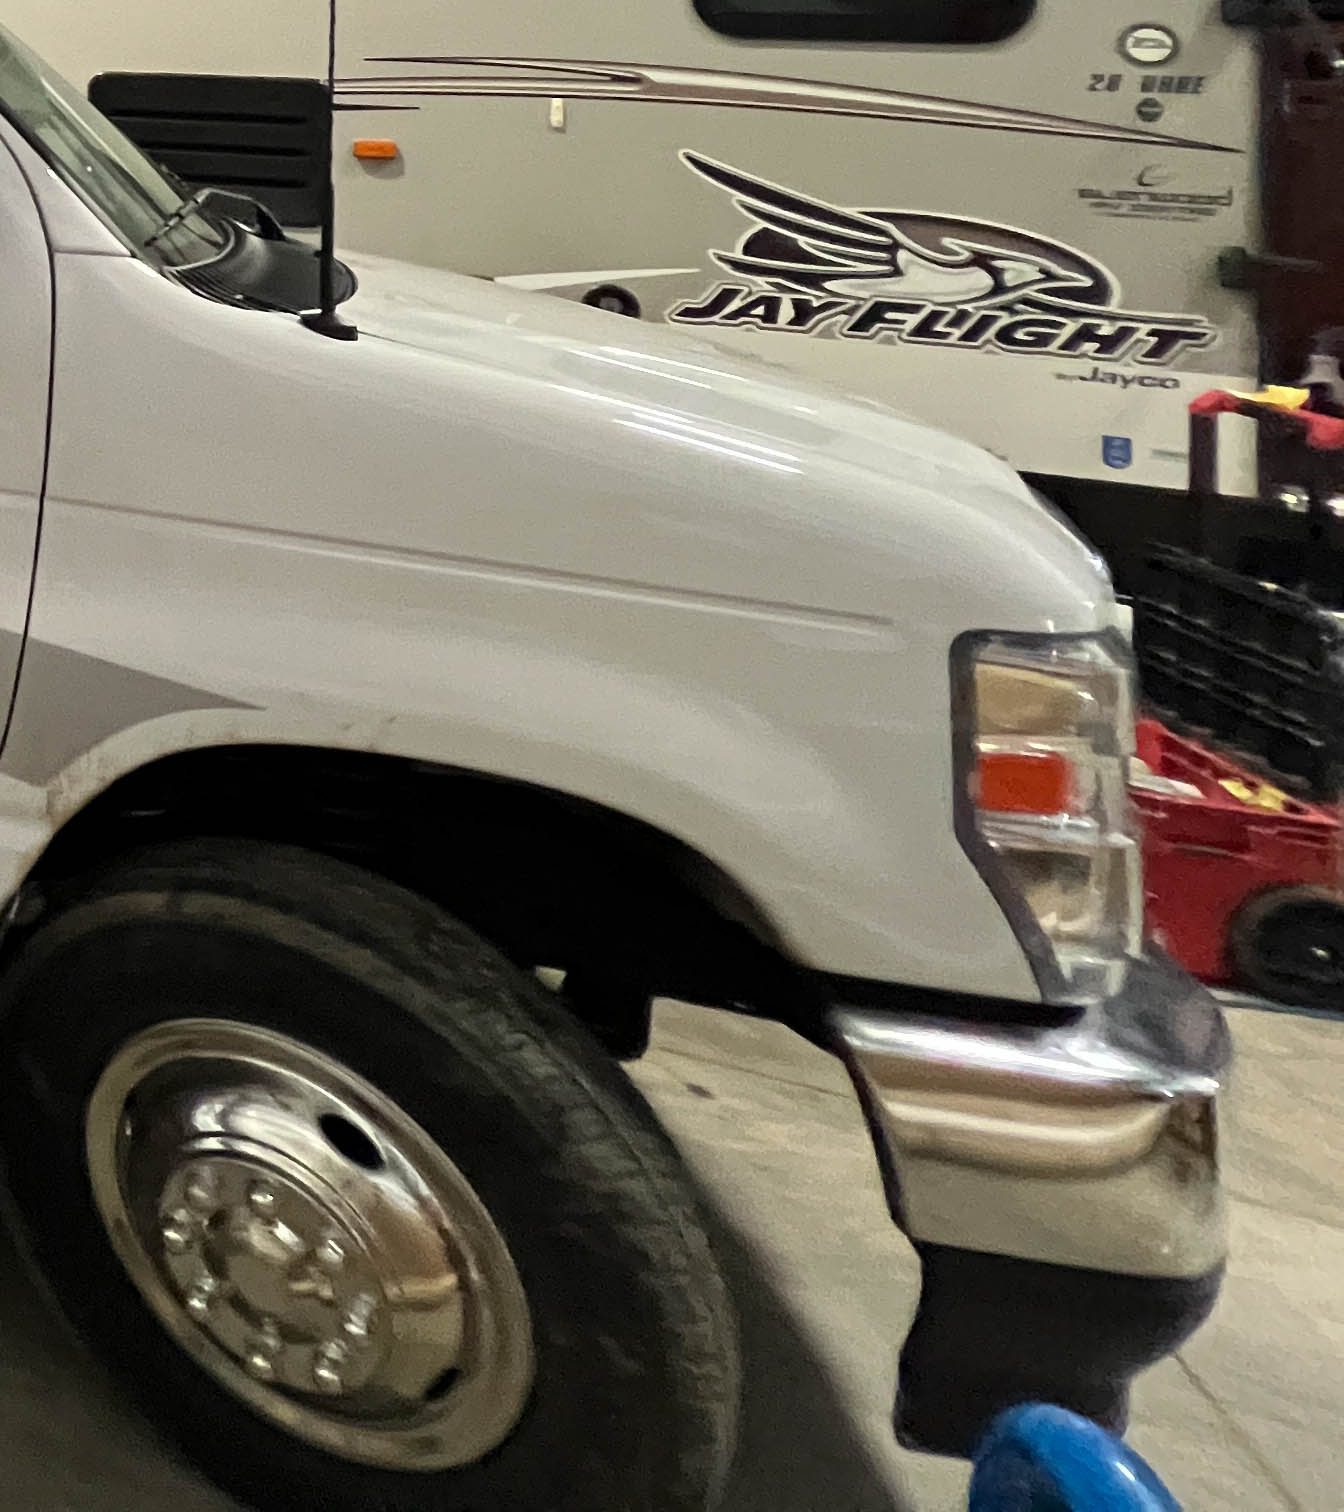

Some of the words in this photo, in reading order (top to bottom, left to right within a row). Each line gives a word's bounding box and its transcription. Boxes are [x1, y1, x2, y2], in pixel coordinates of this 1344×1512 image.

[674, 286, 849, 328] JAY
[844, 299, 1210, 361] FLIGHT
[1078, 365, 1181, 390] Jayco
